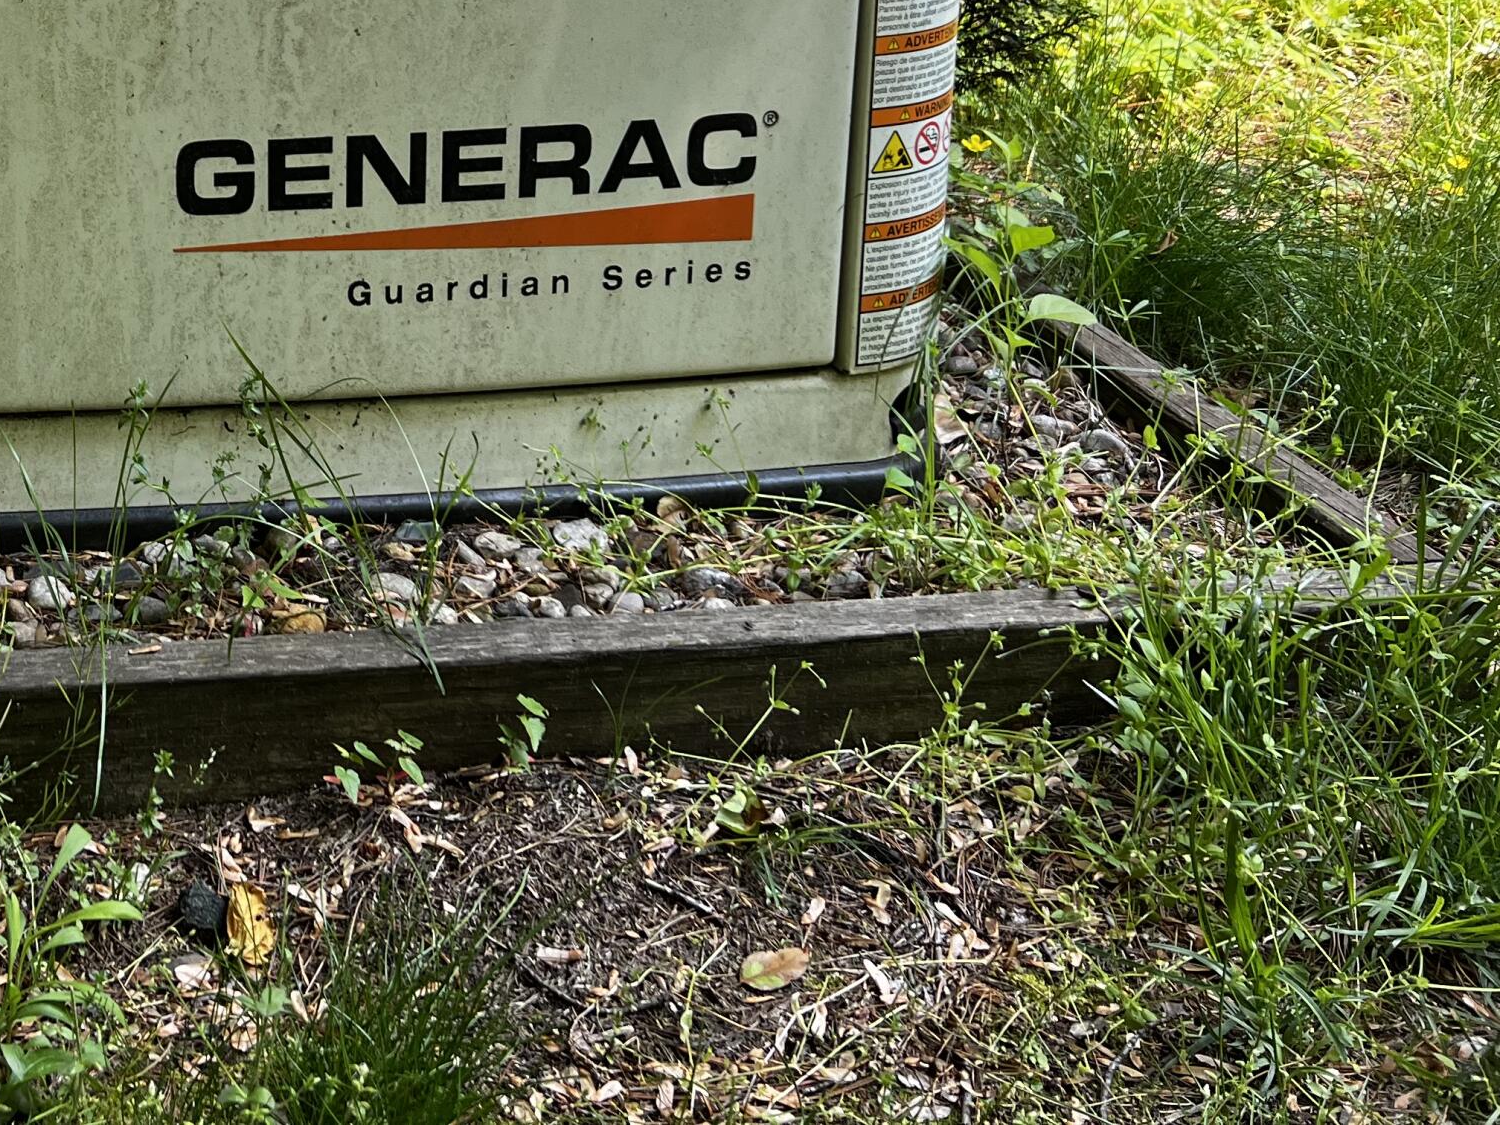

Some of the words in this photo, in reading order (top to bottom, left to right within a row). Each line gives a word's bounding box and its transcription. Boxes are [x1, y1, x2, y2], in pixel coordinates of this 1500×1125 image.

[176, 112, 759, 216] GENERAC
[870, 181, 901, 190] Explosion
[347, 273, 570, 306] Guardian
[602, 259, 753, 291] Series
